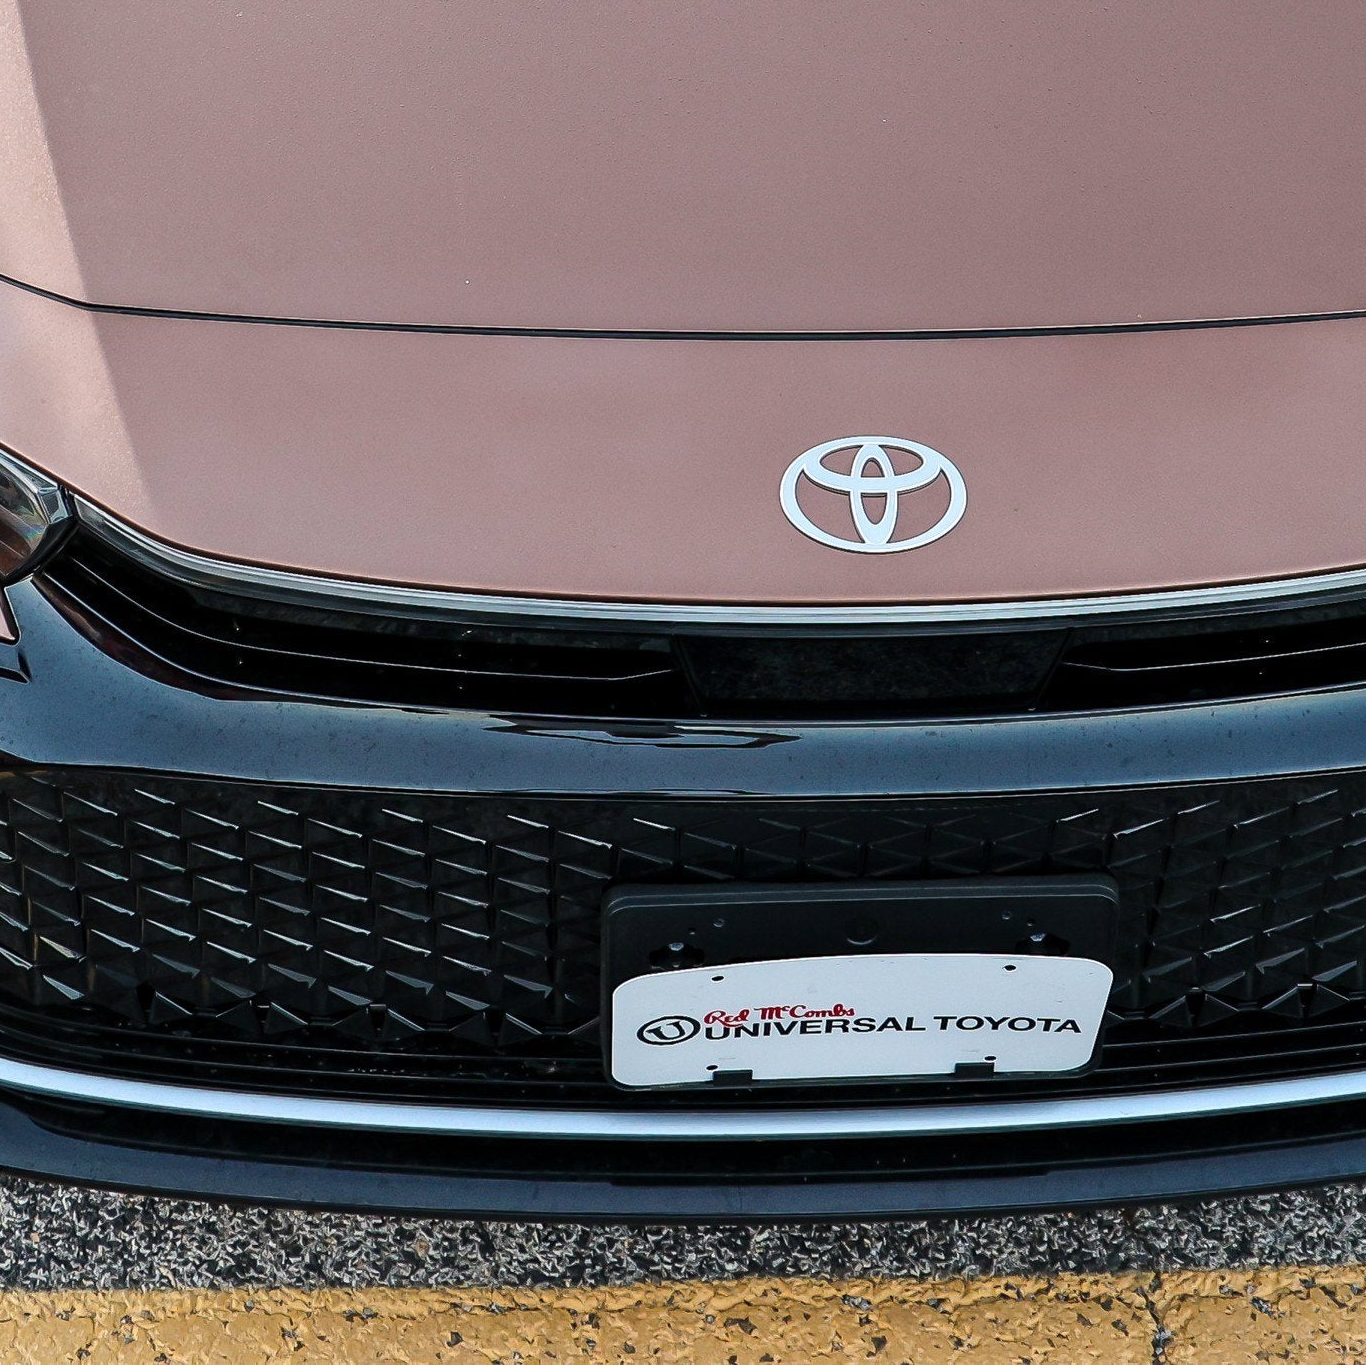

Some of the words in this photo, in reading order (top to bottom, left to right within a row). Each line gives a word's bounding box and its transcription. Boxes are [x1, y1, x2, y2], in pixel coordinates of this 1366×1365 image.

[704, 1008, 751, 1029] Red
[753, 1003, 856, 1021] McCombs
[704, 1015, 927, 1041] UNIVERSAL
[933, 1015, 1083, 1034] TOYOTA
